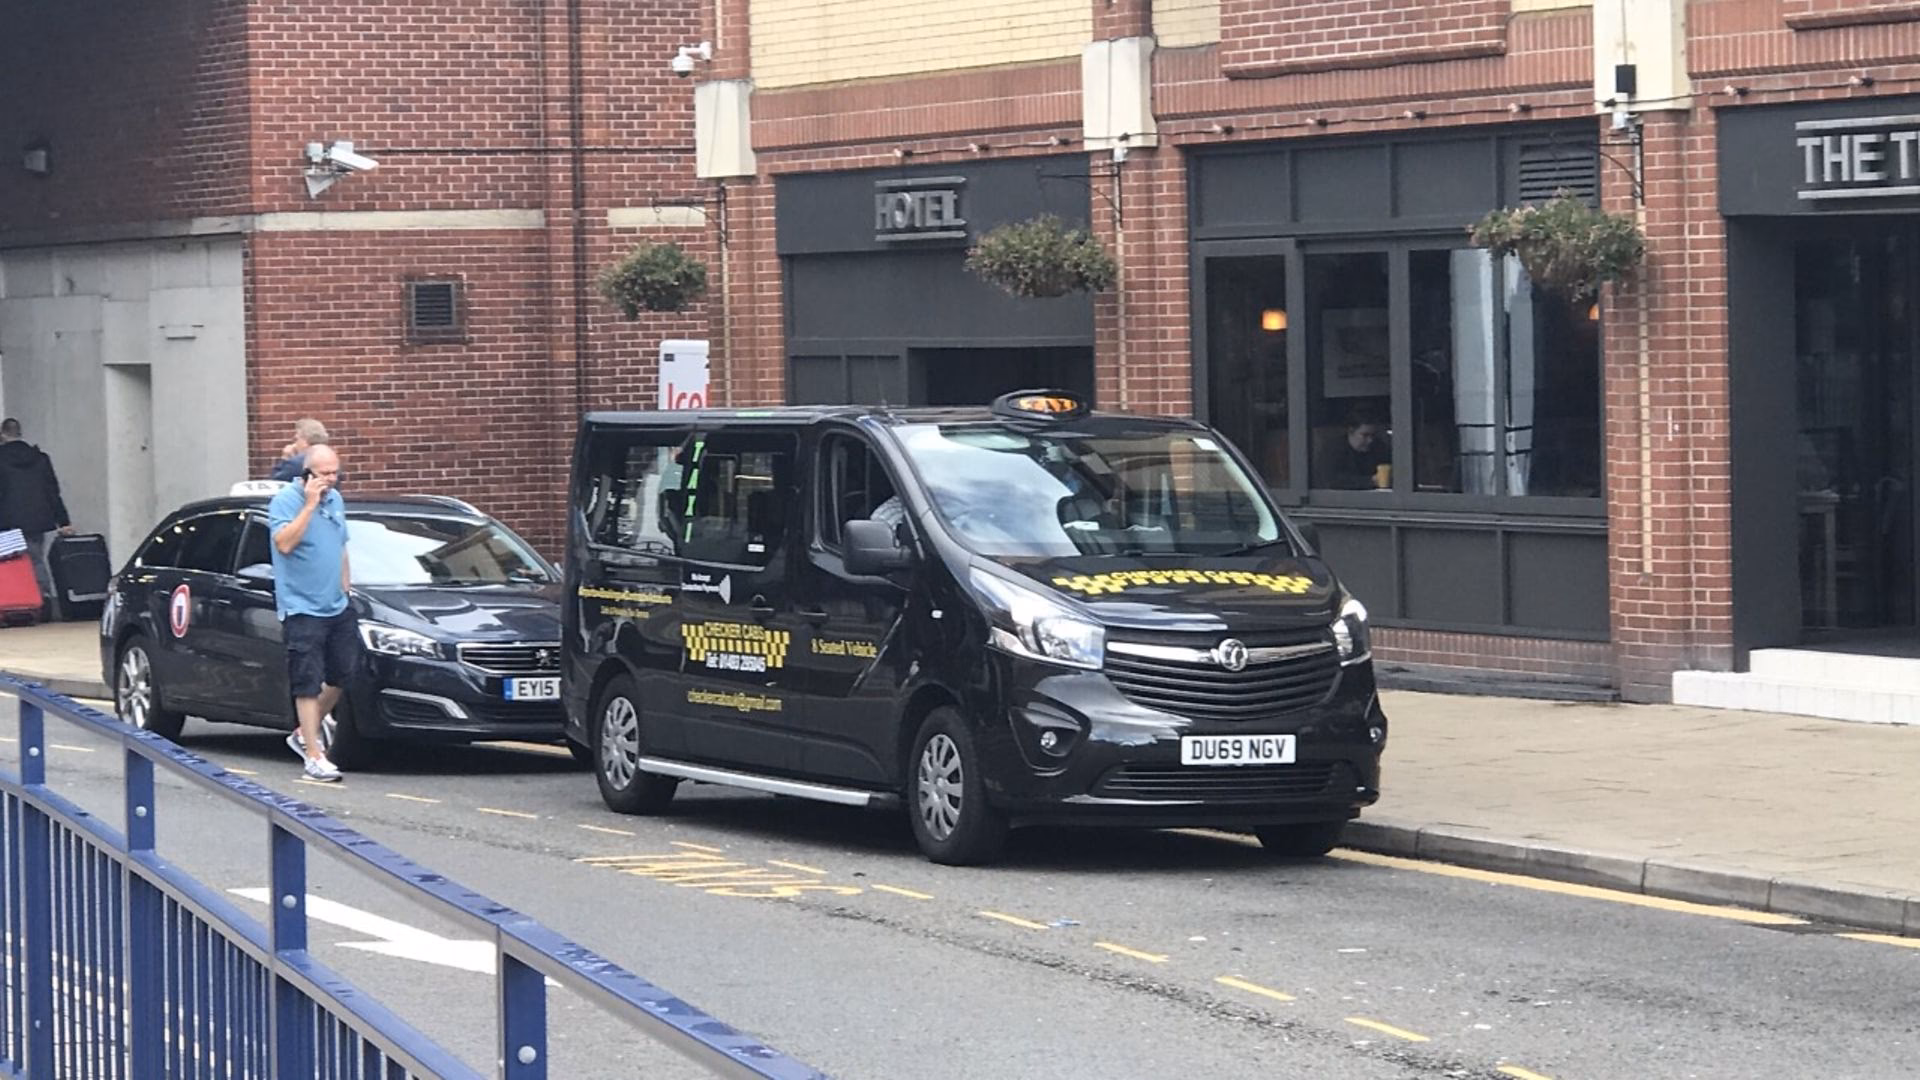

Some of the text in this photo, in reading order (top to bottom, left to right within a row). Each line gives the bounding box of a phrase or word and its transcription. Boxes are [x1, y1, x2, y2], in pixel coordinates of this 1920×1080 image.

[1797, 131, 1920, 183] THE T
[875, 190, 967, 230] HOTEL
[1111, 569, 1203, 580] CHECKER
[704, 621, 766, 640] CHECKER CABS
[819, 638, 845, 655] Seated
[845, 640, 878, 658] Vehicle
[518, 680, 554, 697] EY15
[1191, 739, 1286, 760] DU69 NGV
